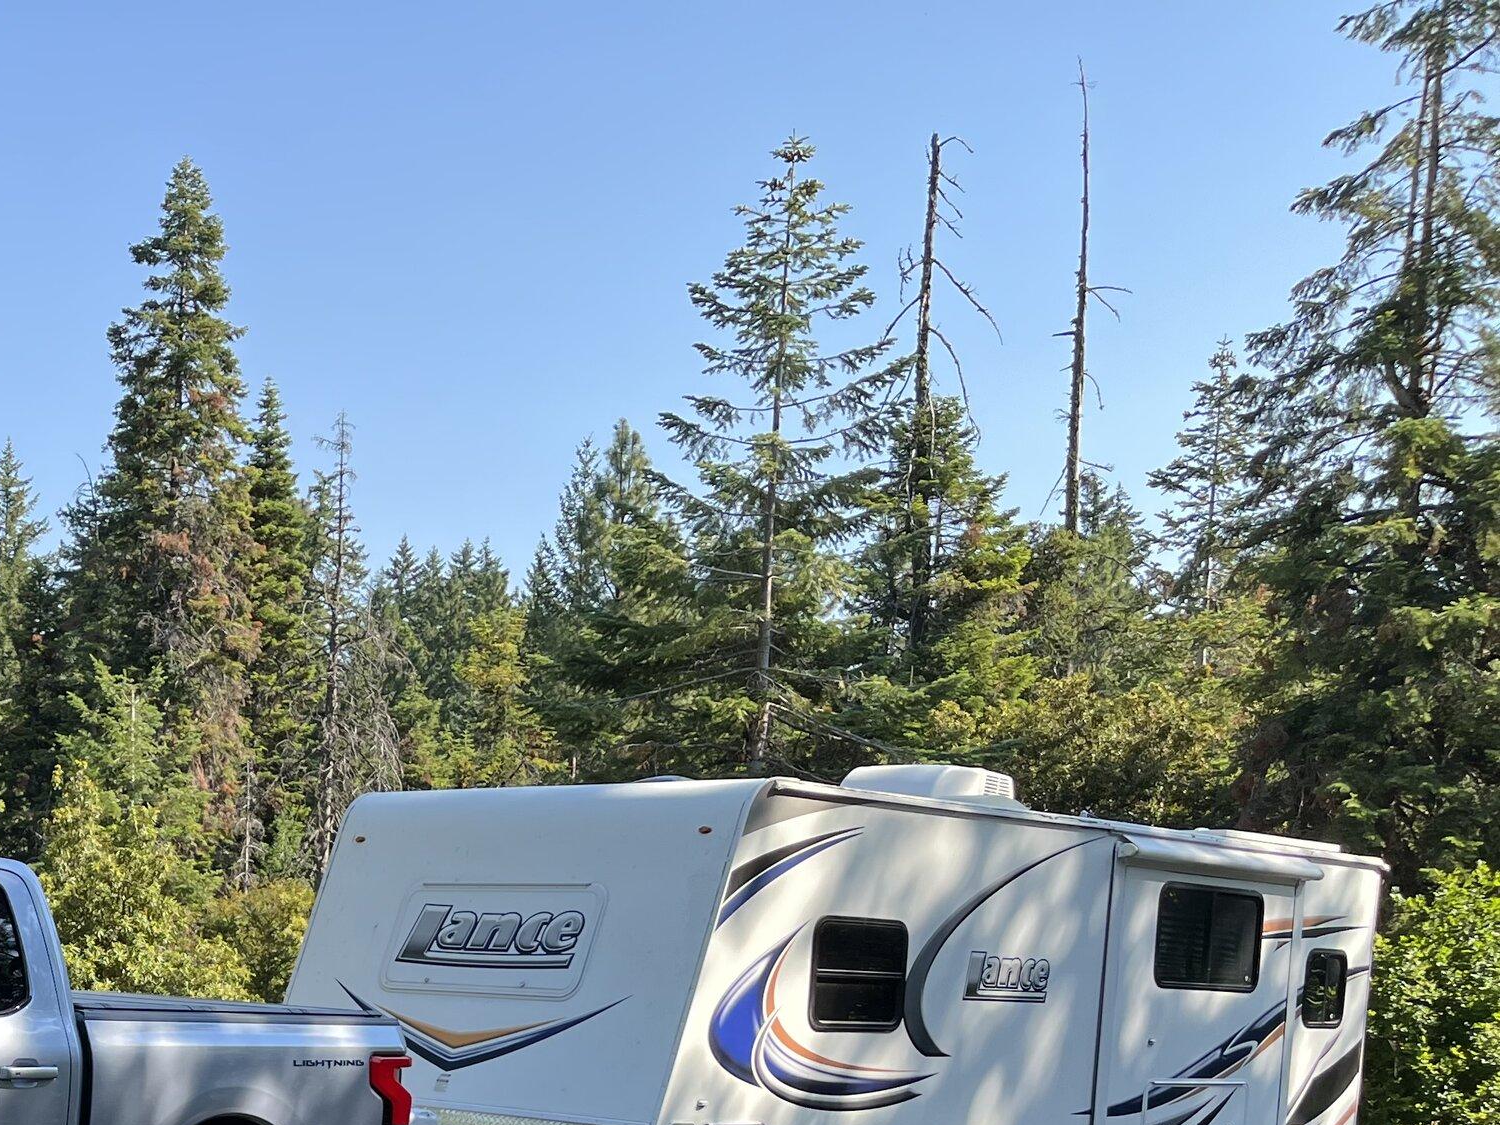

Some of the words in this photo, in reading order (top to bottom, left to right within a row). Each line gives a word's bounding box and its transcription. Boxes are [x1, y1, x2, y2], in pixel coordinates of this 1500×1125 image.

[395, 903, 585, 969] Lance
[962, 951, 1050, 1003] Lance
[293, 1059, 365, 1069] LIGHTNING
